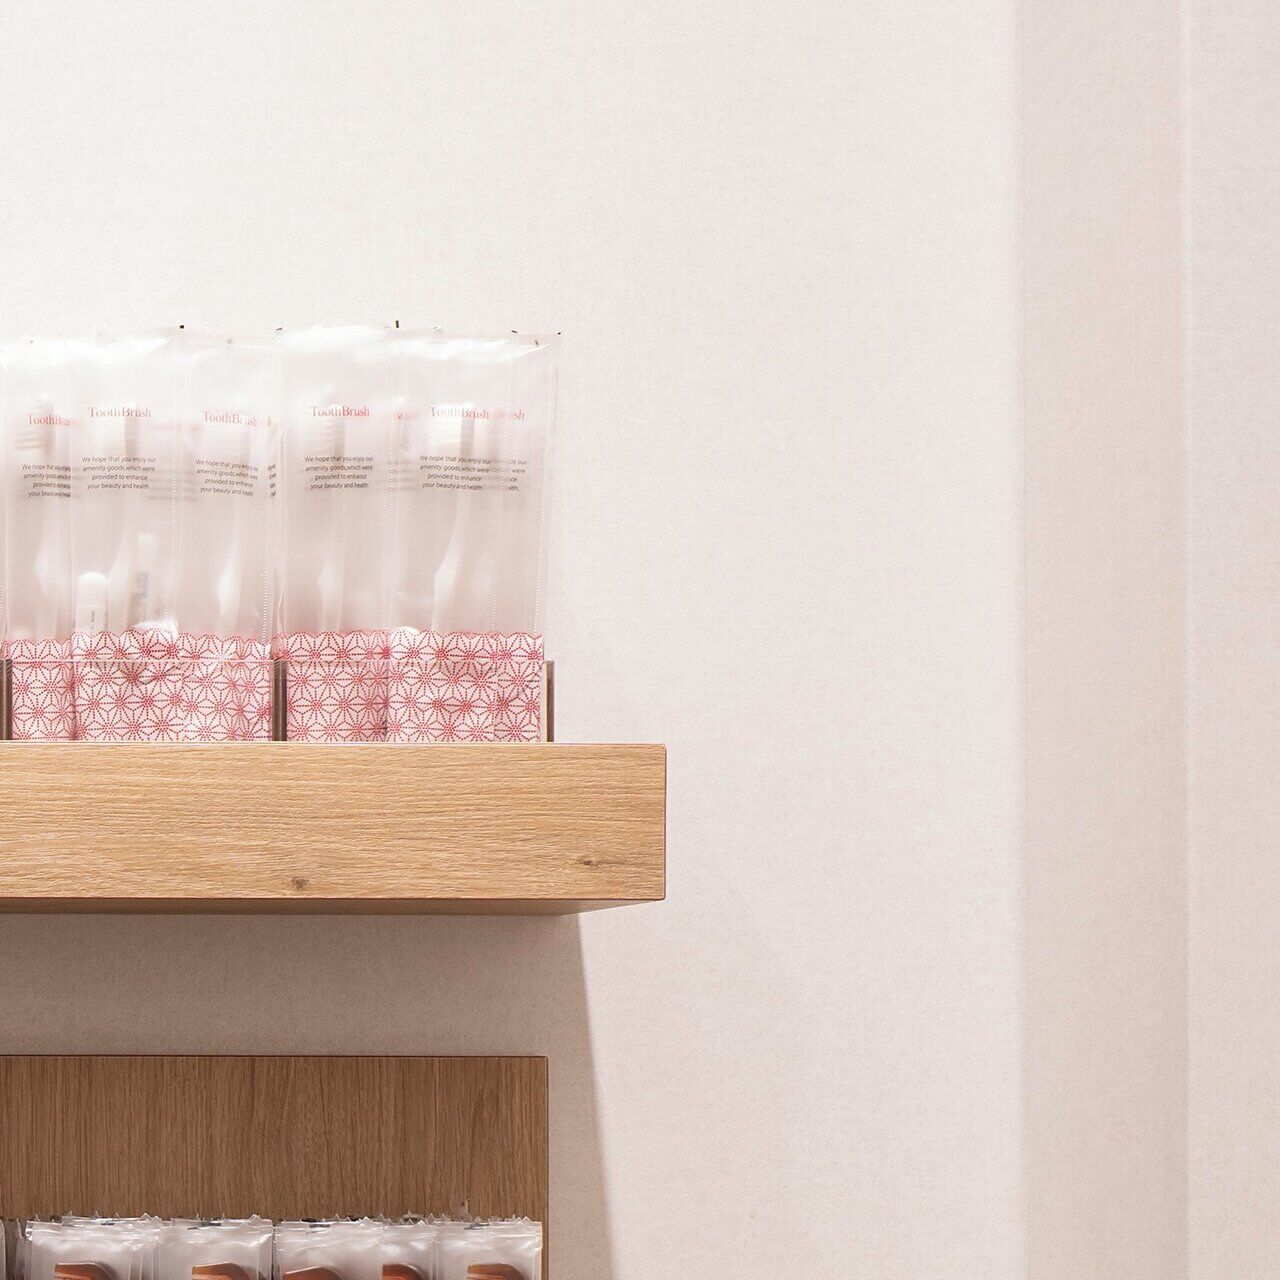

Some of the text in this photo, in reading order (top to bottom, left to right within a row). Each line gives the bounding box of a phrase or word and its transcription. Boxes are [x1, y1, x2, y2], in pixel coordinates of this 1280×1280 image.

[88, 406, 151, 418] ToothBrush
[311, 406, 370, 418] ToothBrush
[430, 407, 489, 420] ToothBrush
